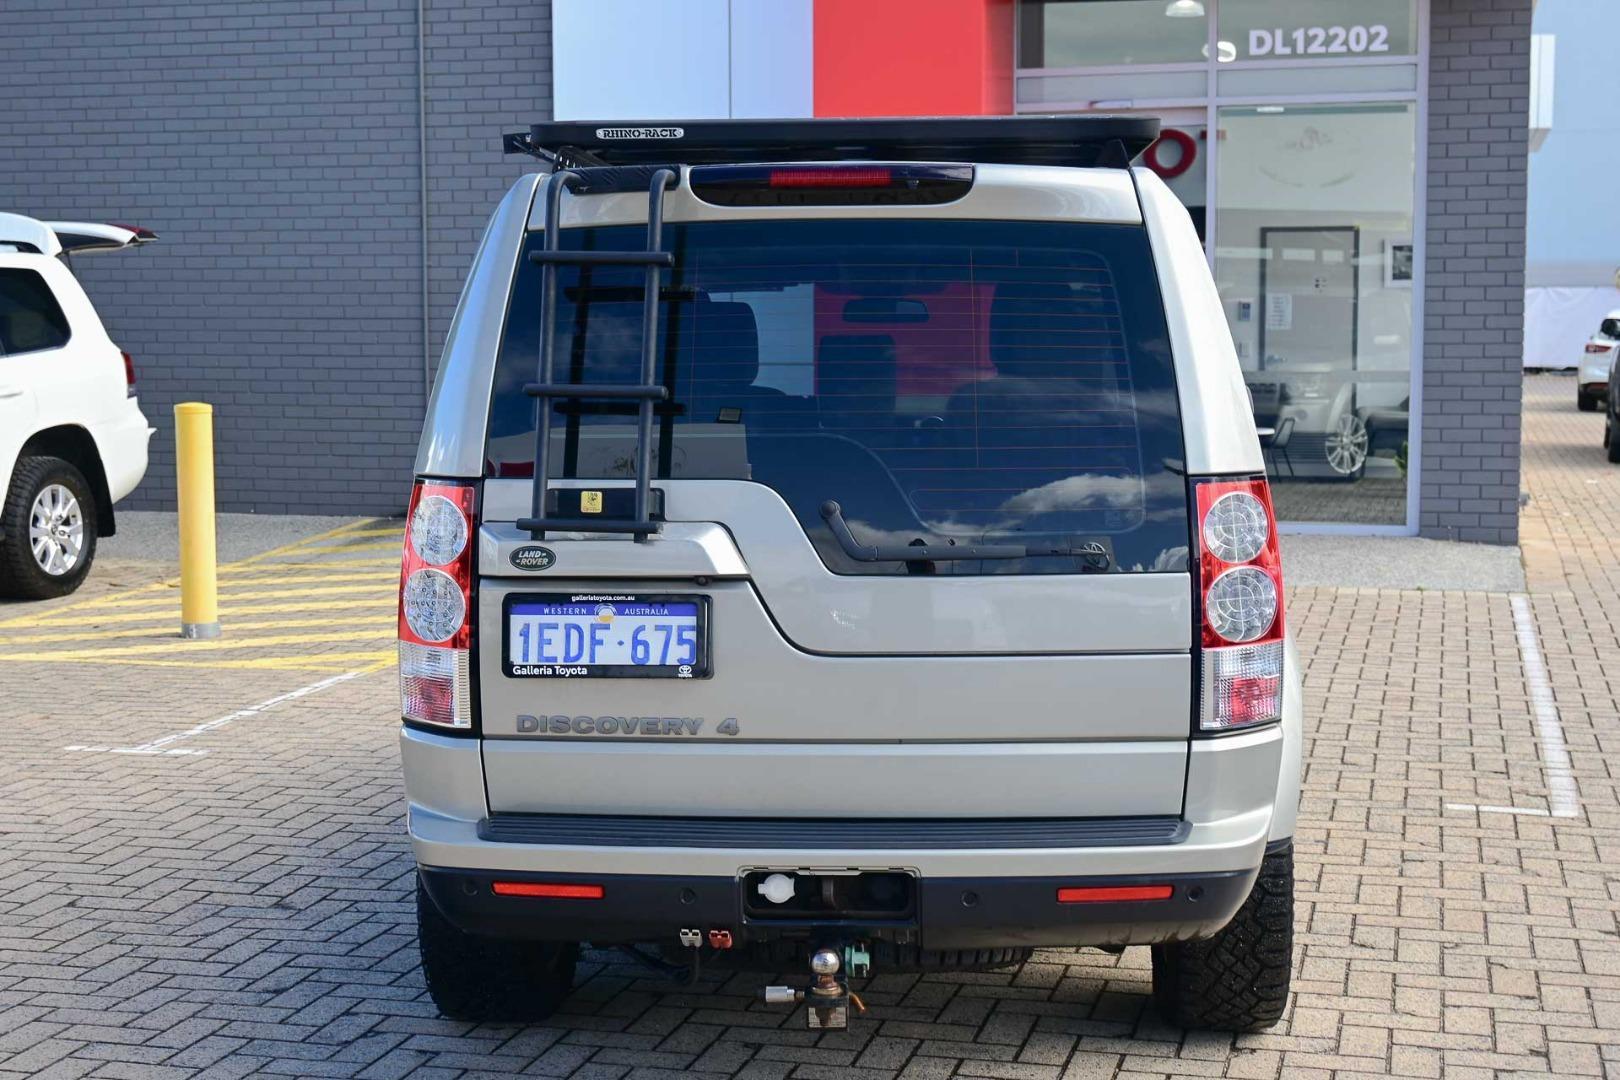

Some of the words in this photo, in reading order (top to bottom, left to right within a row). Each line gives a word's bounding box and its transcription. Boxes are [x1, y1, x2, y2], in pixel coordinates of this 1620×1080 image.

[1248, 24, 1389, 56] DL12202
[602, 128, 678, 138] RHINO-RACK
[571, 594, 635, 602] galleriatoyota.com.au
[543, 607, 587, 615] WESTERN
[512, 665, 553, 675] Galleria
[553, 665, 588, 677] Toyota
[516, 714, 704, 735] DISCOVERY
[716, 717, 740, 736] 4
